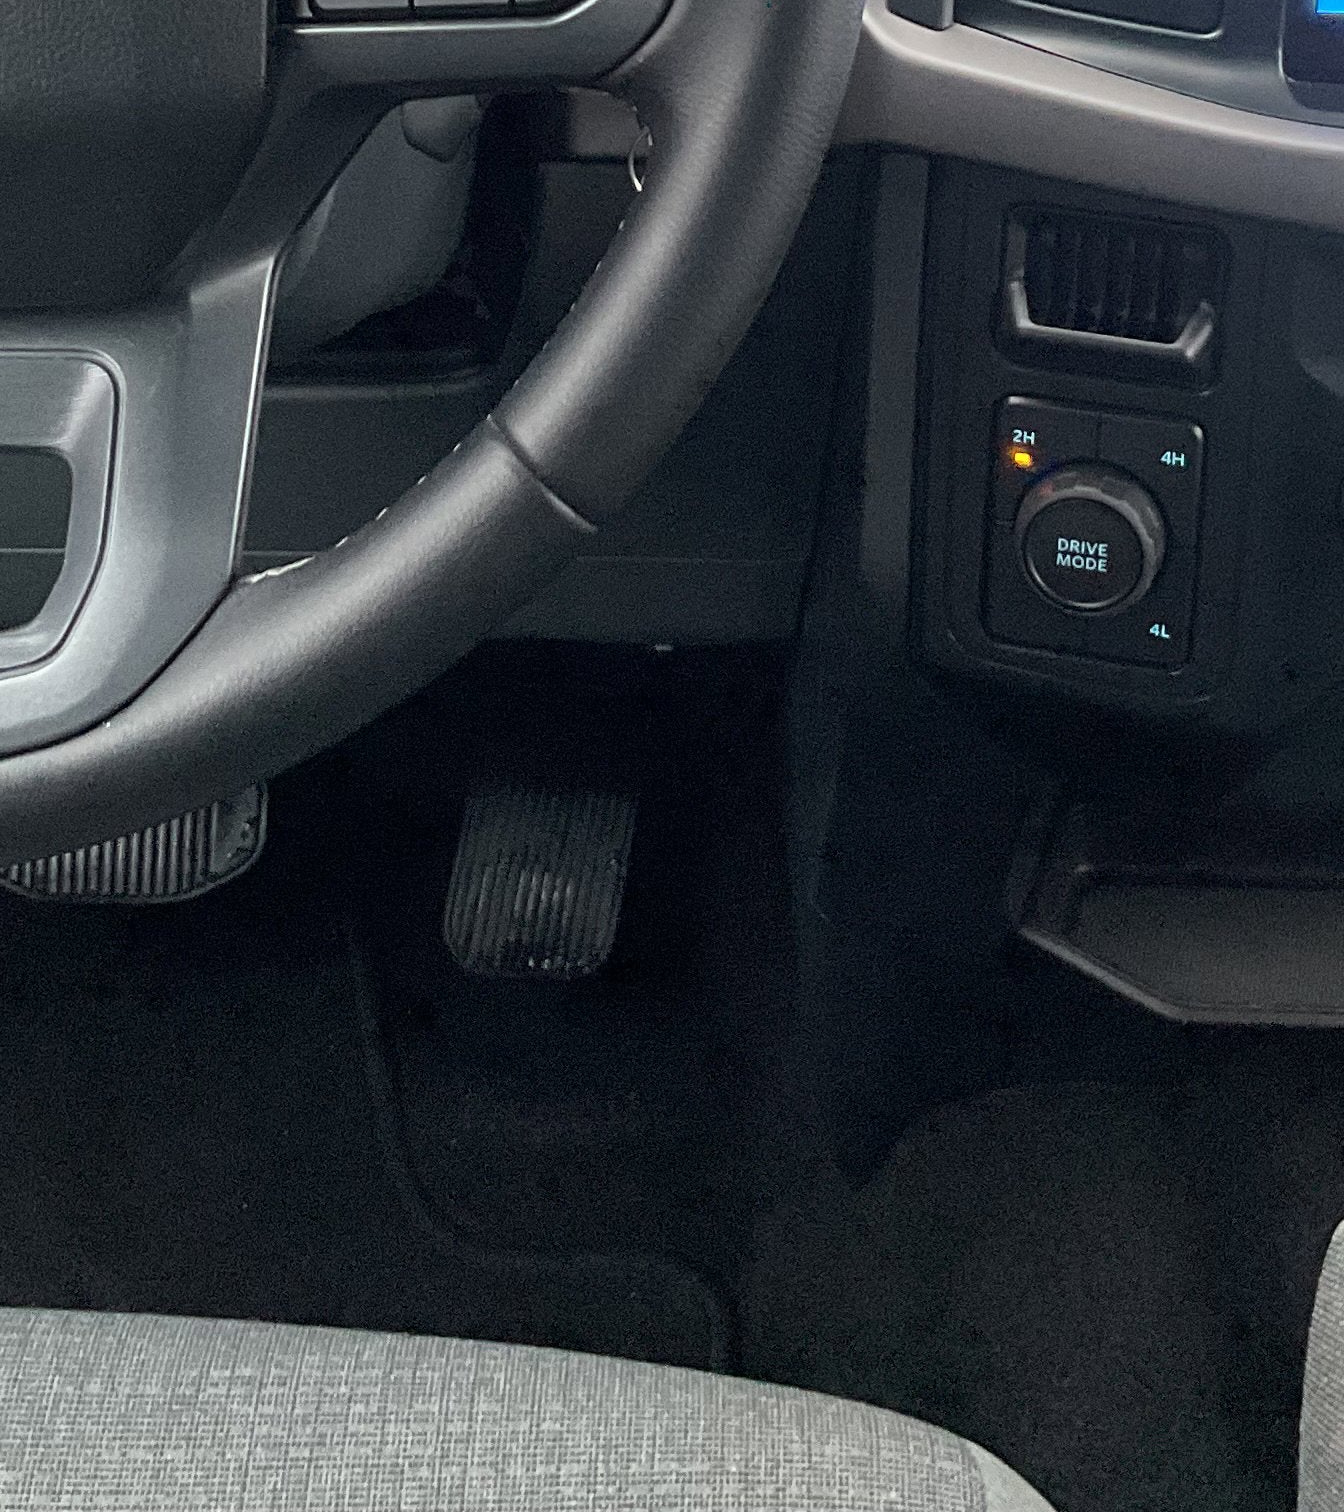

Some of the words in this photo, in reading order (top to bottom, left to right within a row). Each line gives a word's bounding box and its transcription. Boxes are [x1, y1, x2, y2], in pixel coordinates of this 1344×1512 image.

[1012, 429, 1035, 445] 2H
[1160, 451, 1185, 467] 4H
[1057, 537, 1108, 557] DRIVE
[1056, 553, 1108, 573] MODE
[1149, 623, 1170, 639] 4L
